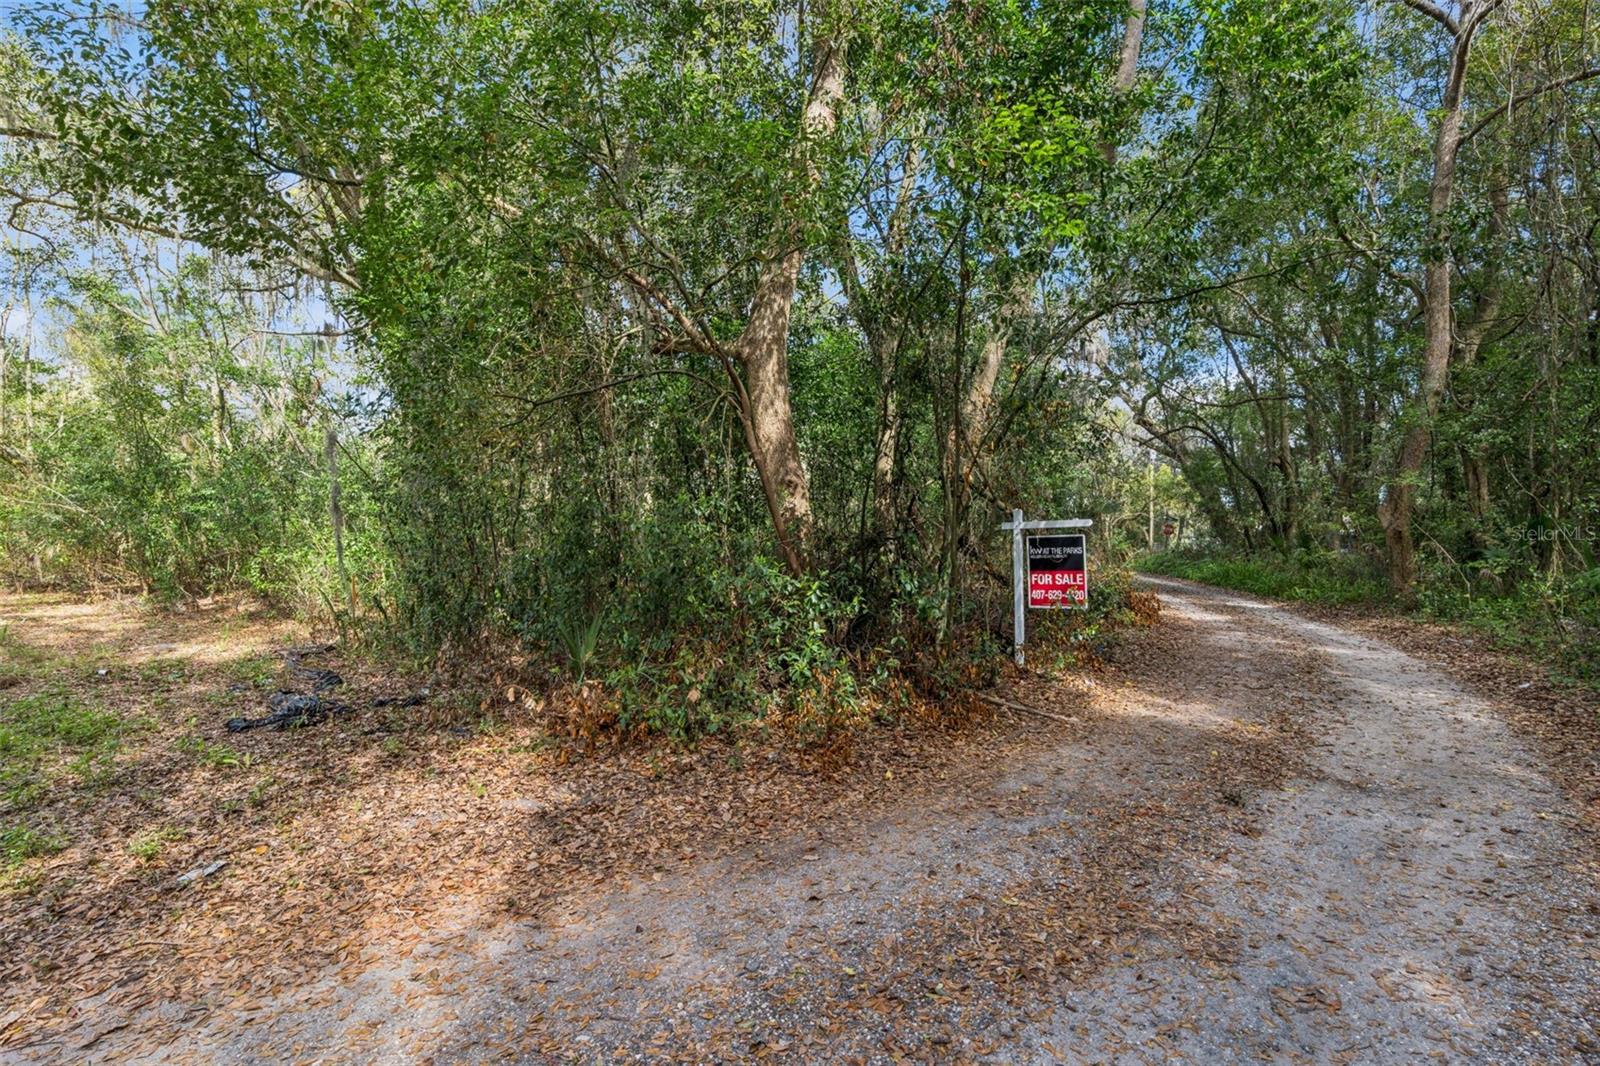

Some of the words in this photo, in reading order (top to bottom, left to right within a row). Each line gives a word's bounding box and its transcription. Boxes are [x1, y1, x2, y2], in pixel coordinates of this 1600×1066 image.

[1032, 574, 1052, 585] FOR
[1055, 574, 1083, 584] SALE
[1032, 590, 1084, 600] 407-629-20
